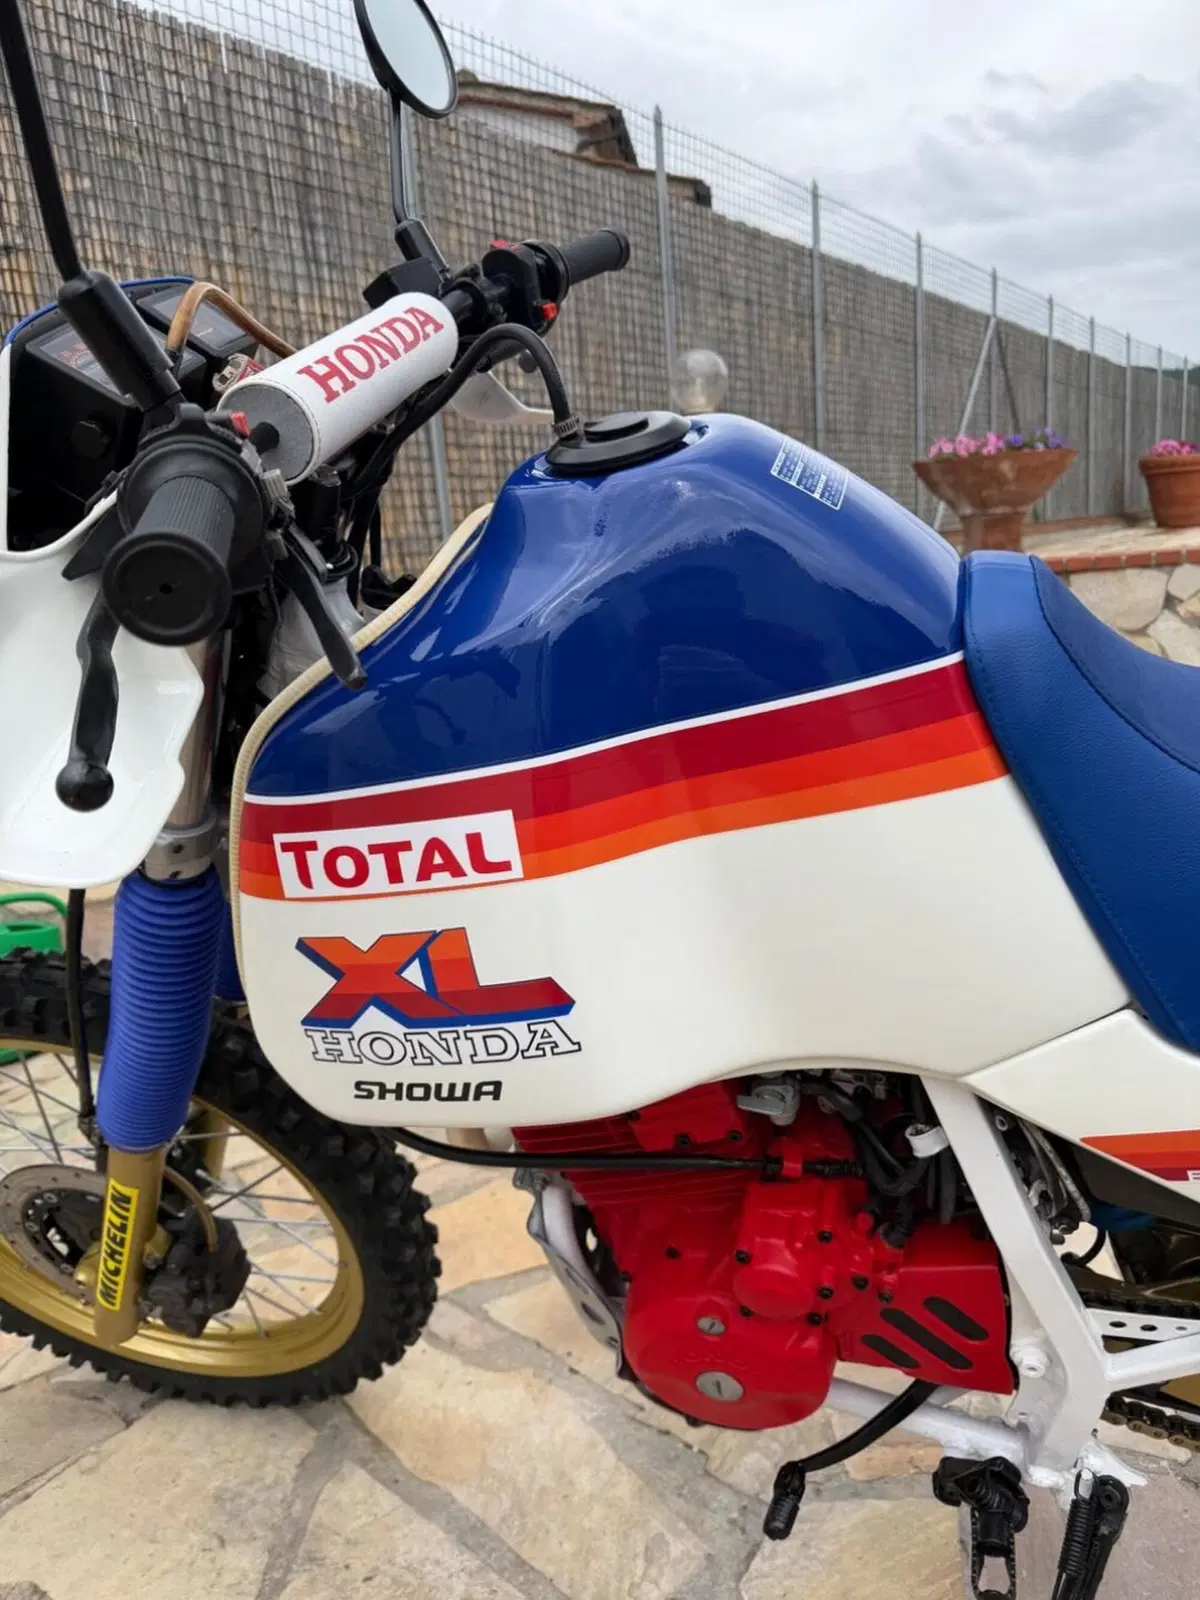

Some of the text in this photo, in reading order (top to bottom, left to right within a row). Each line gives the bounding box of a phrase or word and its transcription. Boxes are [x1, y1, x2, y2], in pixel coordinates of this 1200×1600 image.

[297, 308, 444, 403] HONDA
[281, 833, 512, 889] TOTAL
[295, 927, 576, 1029] XL
[306, 1020, 582, 1066] HONDA
[354, 1081, 502, 1102] SHOWA
[100, 1187, 132, 1306] MICHELIN
